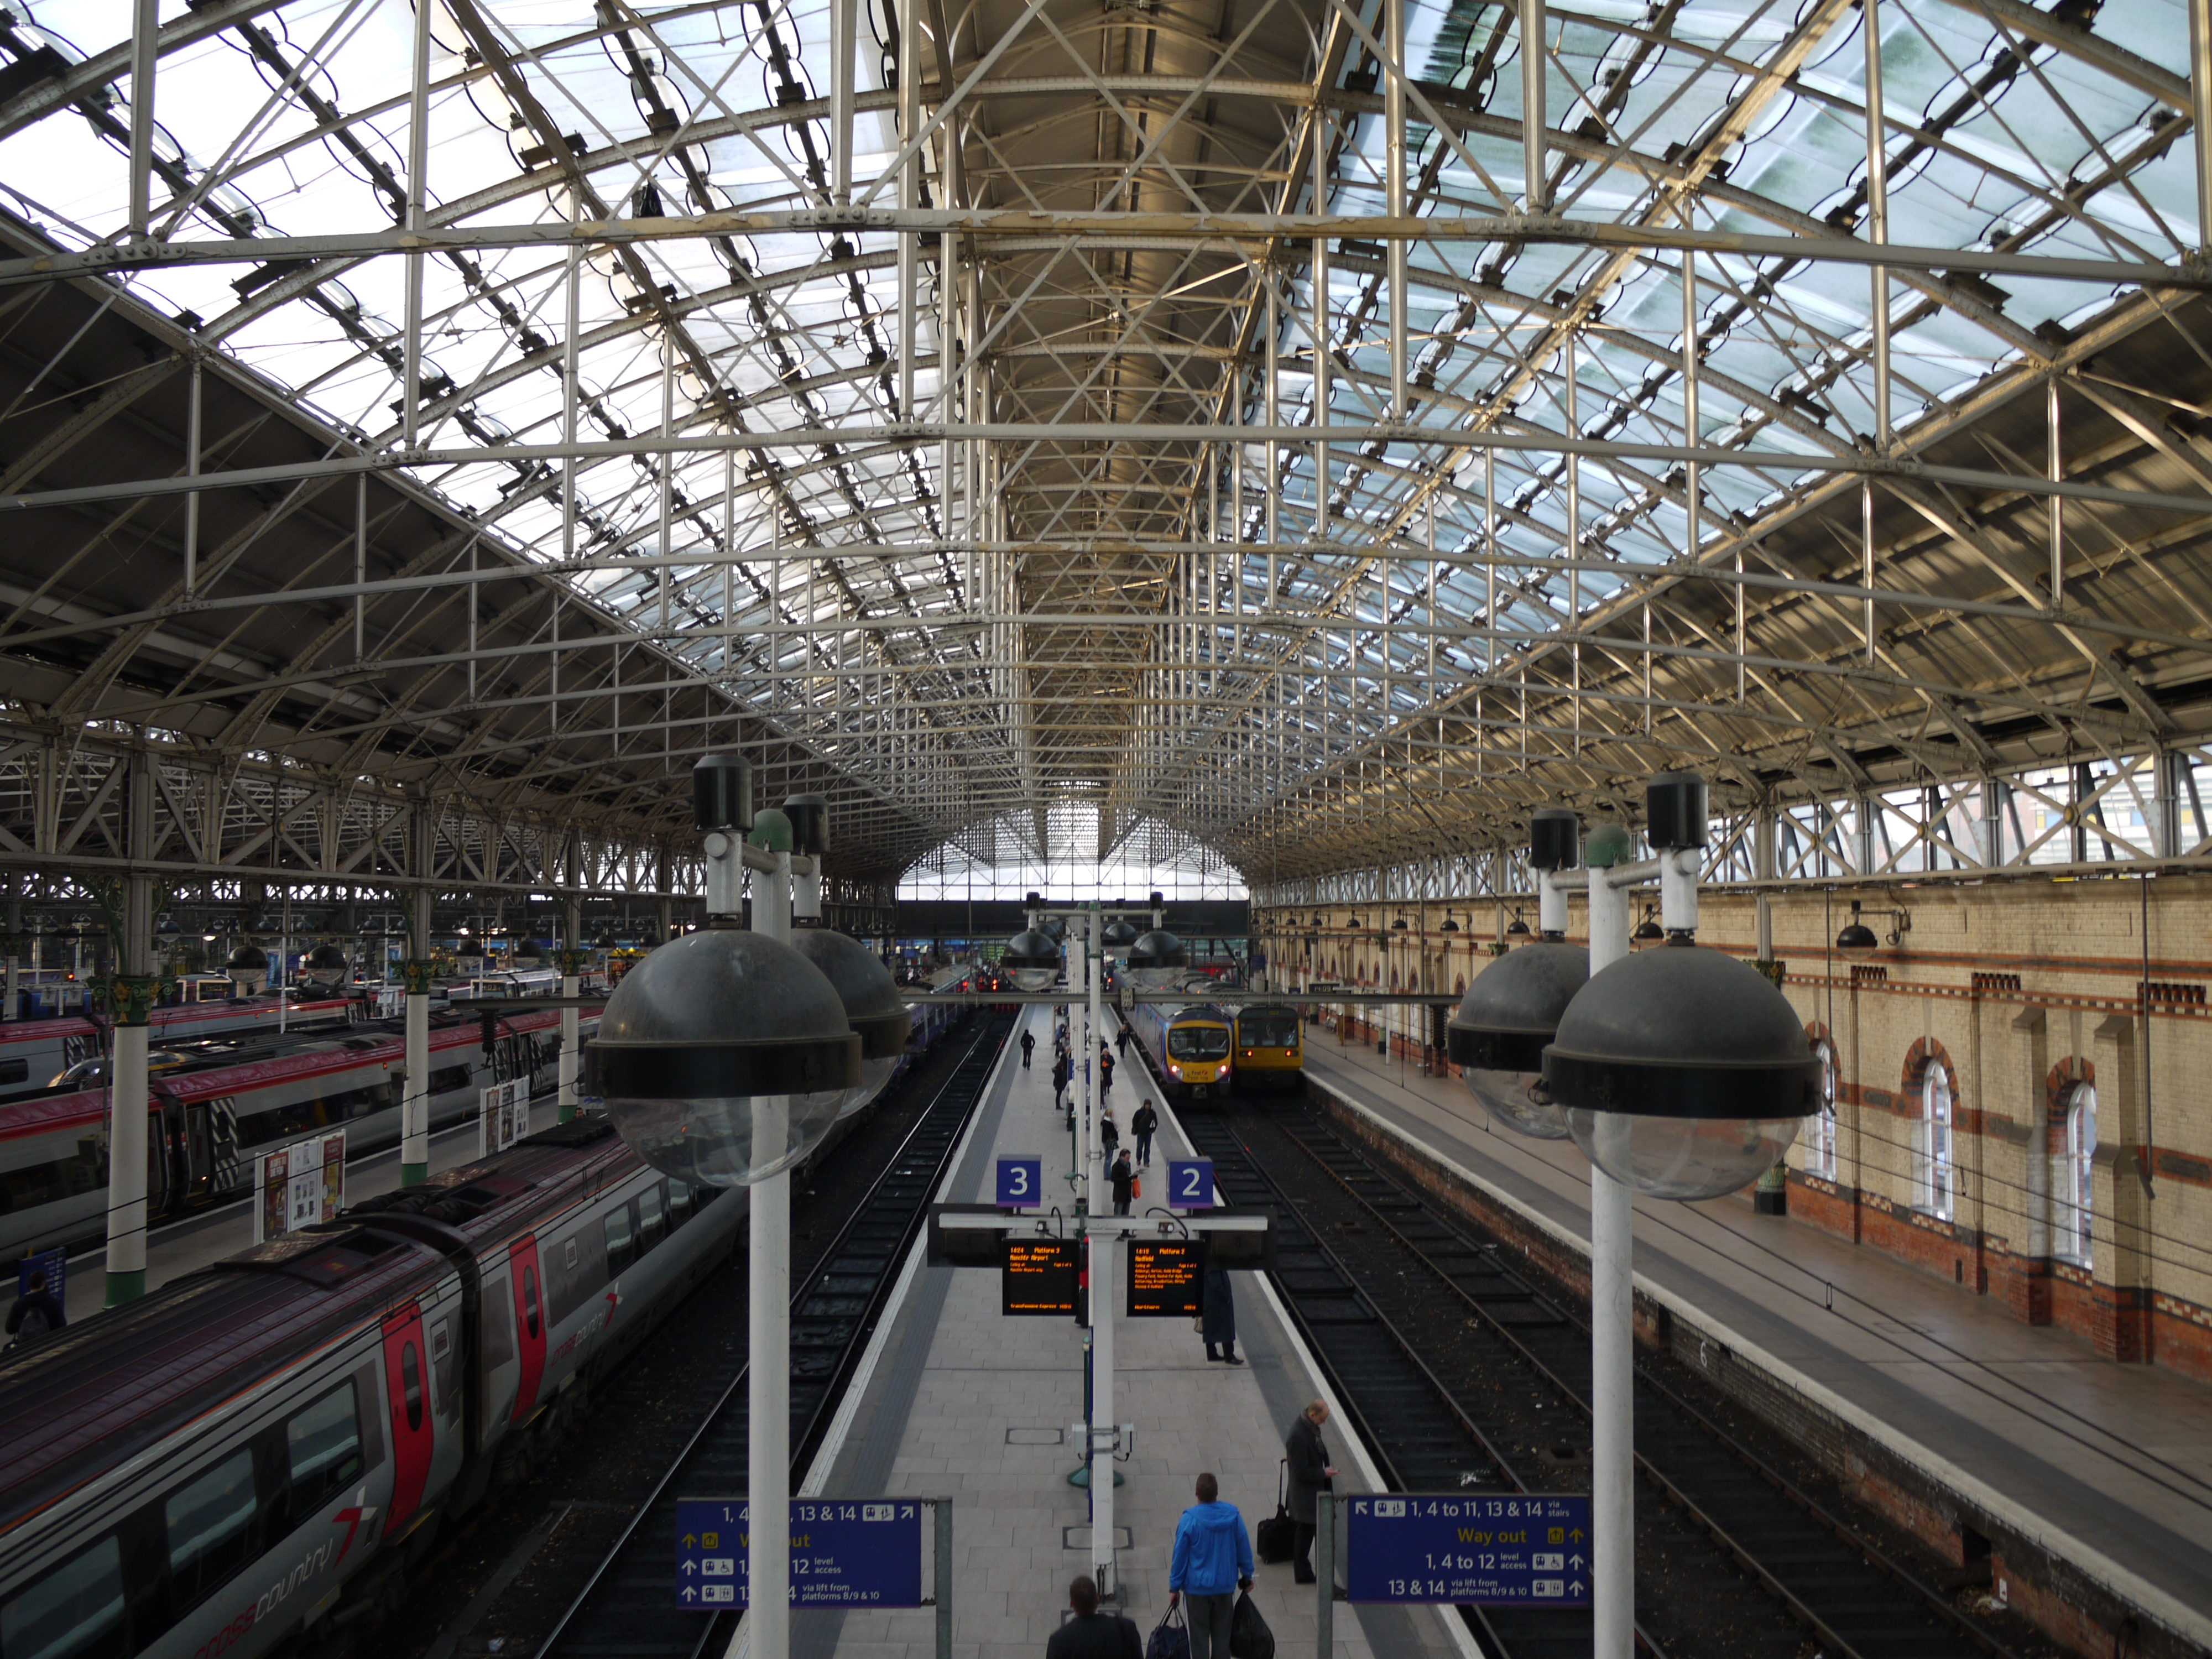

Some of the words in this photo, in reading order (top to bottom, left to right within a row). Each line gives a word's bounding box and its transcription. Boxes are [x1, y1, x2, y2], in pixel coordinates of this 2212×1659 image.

[1009, 1167, 1028, 1196] 3
[1182, 1168, 1201, 1196] 2
[723, 1506, 734, 1524] 1,
[799, 1506, 816, 1521] 13
[821, 1506, 833, 1521] &
[838, 1506, 857, 1521] 14
[1411, 1501, 1422, 1519] 1,
[1427, 1501, 1438, 1517] 4
[1442, 1503, 1459, 1517] to
[1463, 1501, 1481, 1519] 11,
[1486, 1501, 1503, 1517] 13
[1507, 1501, 1520, 1517] &
[1525, 1501, 1542, 1517] 14
[1548, 1509, 1570, 1517] stairs
[789, 1533, 811, 1547] ut
[1457, 1527, 1493, 1546] Way
[1498, 1530, 1527, 1543] out
[814, 1557, 834, 1565] level
[1425, 1553, 1436, 1571] 1,
[1441, 1553, 1453, 1569] 4
[1456, 1554, 1474, 1569] to
[1478, 1553, 1495, 1569] 12
[1500, 1552, 1519, 1561] level
[792, 1558, 809, 1574] 12
[816, 1583, 828, 1592] lift
[830, 1582, 850, 1592] from
[1388, 1579, 1406, 1595] 13
[1410, 1579, 1422, 1595] &
[1427, 1580, 1446, 1595] 14
[1451, 1579, 1463, 1587] via
[1465, 1578, 1477, 1587] lift
[1478, 1578, 1498, 1587] from
[739, 1585, 749, 1601] 1
[802, 1591, 841, 1602] platforms
[843, 1591, 859, 1601] 8/9
[860, 1591, 868, 1600] &
[870, 1591, 880, 1600] 10
[1450, 1587, 1489, 1598] platforms
[1491, 1587, 1507, 1597] 8/9
[1509, 1587, 1516, 1596] &
[1517, 1587, 1527, 1596] 10
